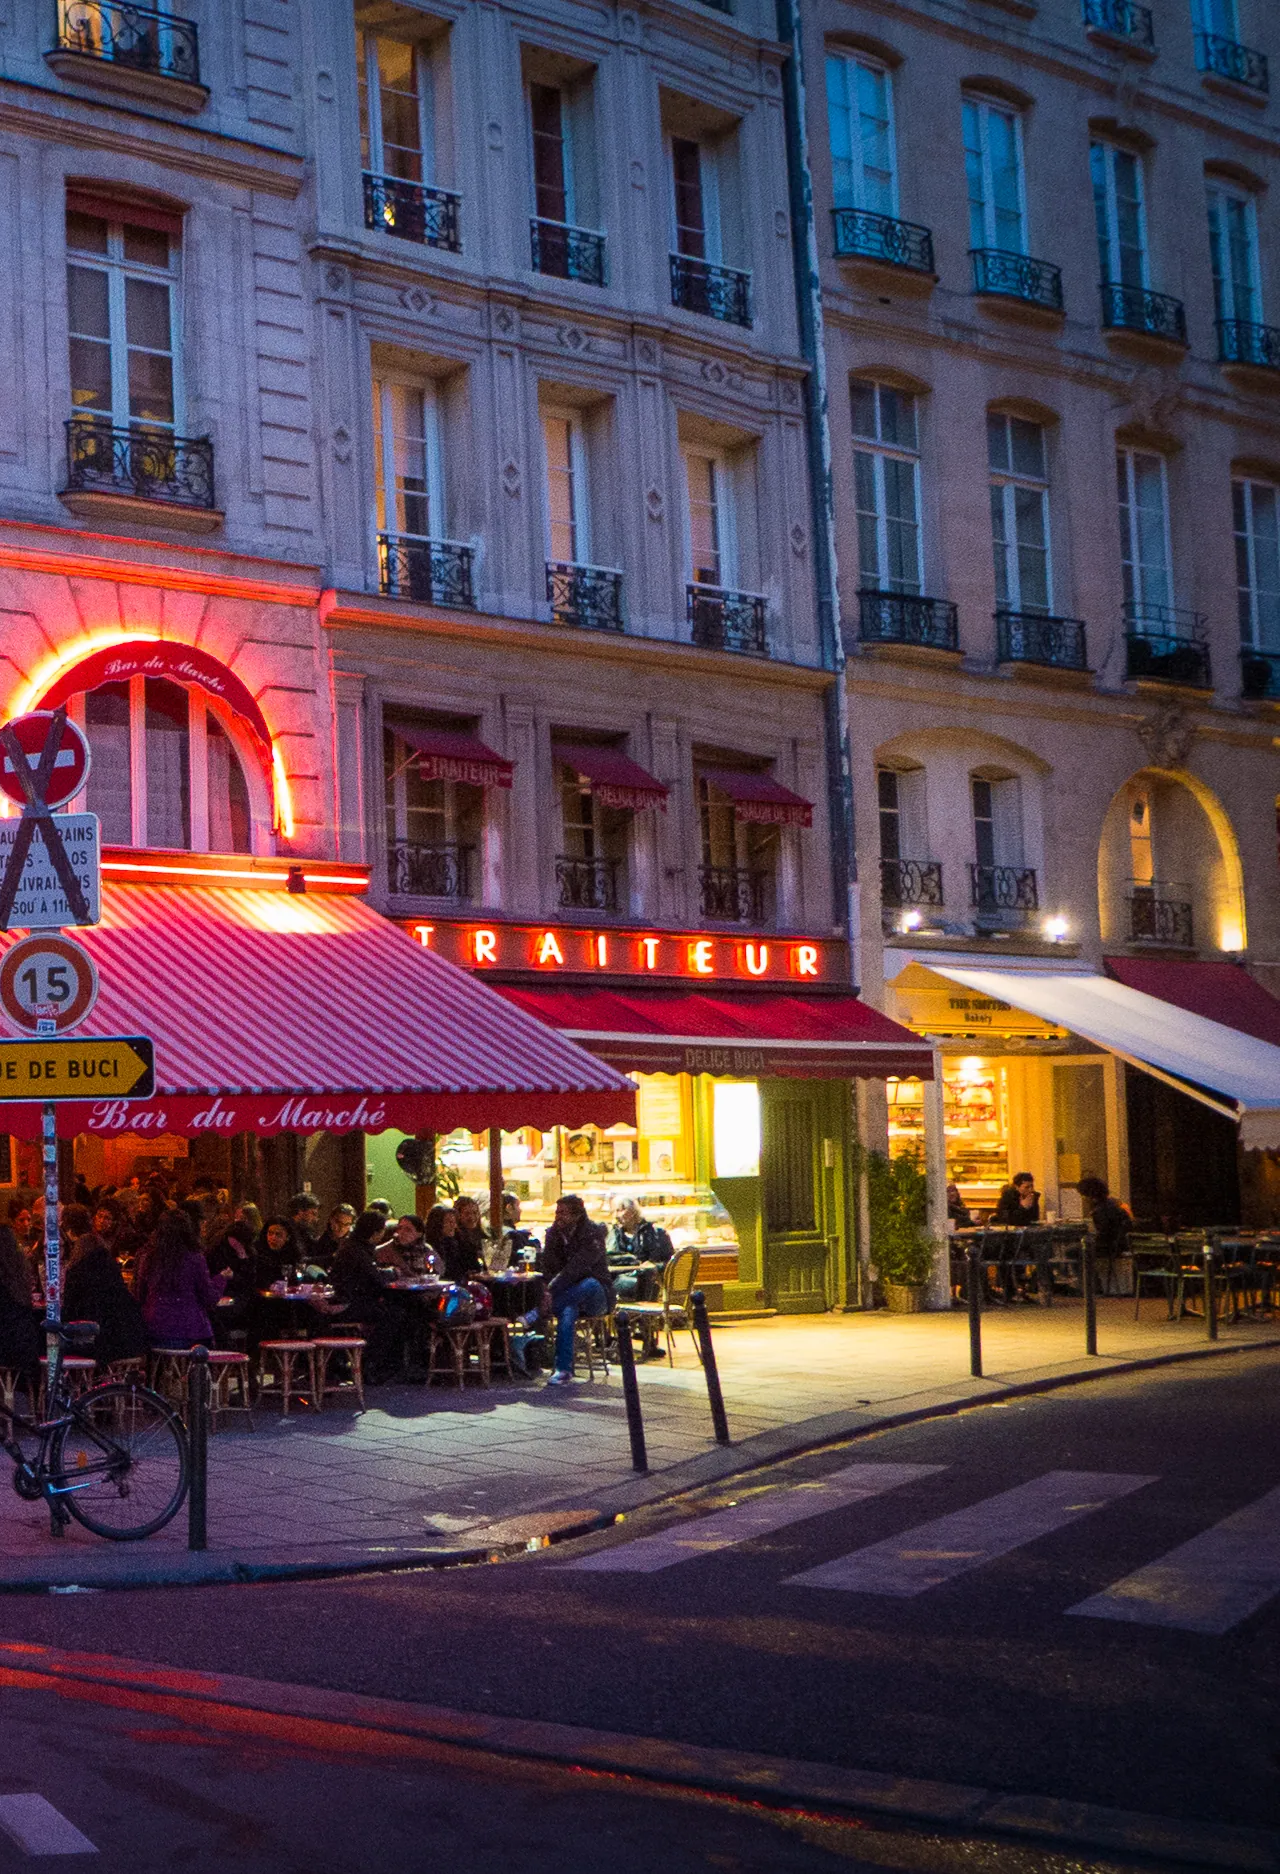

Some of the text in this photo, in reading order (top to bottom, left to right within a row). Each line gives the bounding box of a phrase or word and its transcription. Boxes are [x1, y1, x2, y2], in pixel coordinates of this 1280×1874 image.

[104, 659, 137, 676] Bar
[142, 655, 165, 669] du
[415, 925, 819, 976] TRAITEUR
[22, 966, 70, 1003] 15
[28, 1060, 57, 1080] DE
[68, 1059, 119, 1079] BUCI
[685, 1047, 765, 1070] DELICE BUCI
[88, 1097, 386, 1129] Bar du Marché
